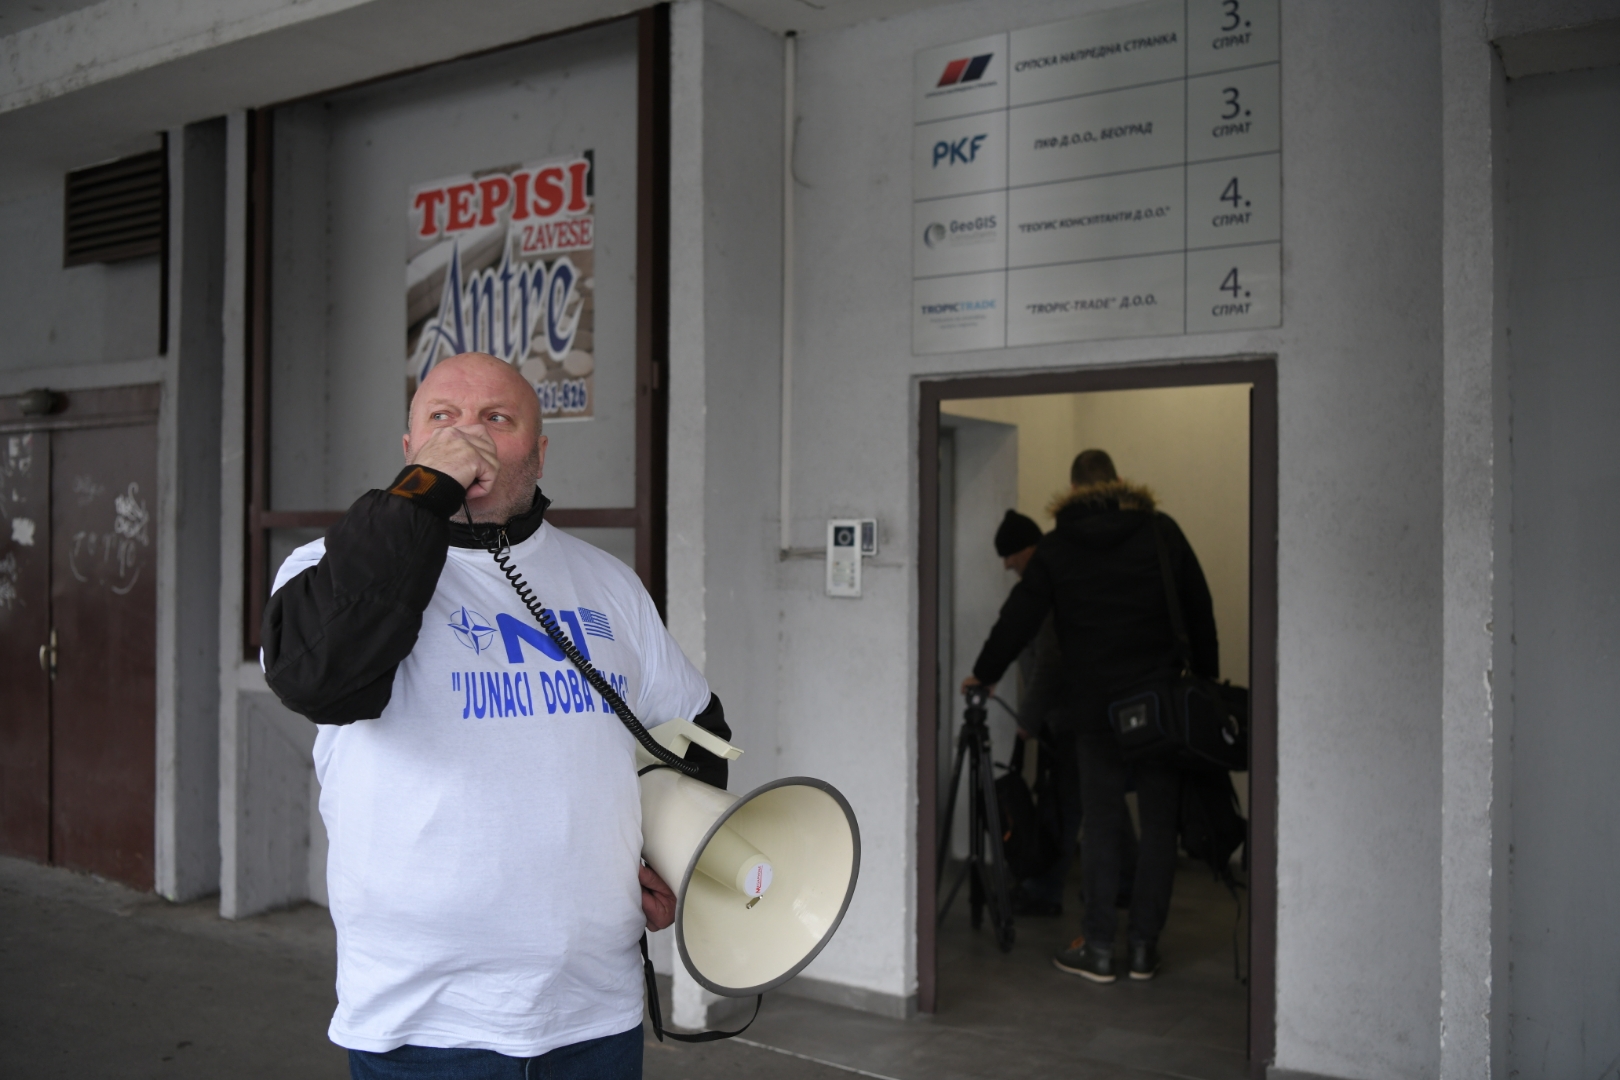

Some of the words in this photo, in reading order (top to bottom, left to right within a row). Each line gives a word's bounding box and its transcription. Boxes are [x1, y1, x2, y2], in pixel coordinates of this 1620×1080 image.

[1220, 0, 1252, 32] 3.
[1014, 54, 1058, 73] СРПСКА
[1059, 42, 1122, 64] НАПРЕДНА
[1123, 32, 1178, 53] СТРАНКА
[1212, 32, 1253, 51] СПРАТ
[1220, 87, 1252, 120] 3.
[1033, 137, 1058, 150] ПКФ
[1100, 121, 1154, 140] БЕОГРАД
[1212, 121, 1253, 139] СПРАТ
[932, 133, 989, 169] PKF
[413, 161, 589, 237] TEPISI
[1219, 176, 1252, 209] 4.
[522, 218, 592, 252] ZAVESE
[949, 214, 998, 234] GeoGIS
[1212, 212, 1253, 228] СПРАТ
[1219, 266, 1252, 299] 4.
[420, 238, 576, 382] Antre
[1212, 302, 1253, 318] СПРАТ
[495, 608, 592, 664] N1
[451, 671, 534, 720] "JUNACI
[539, 669, 595, 715] DOBA
